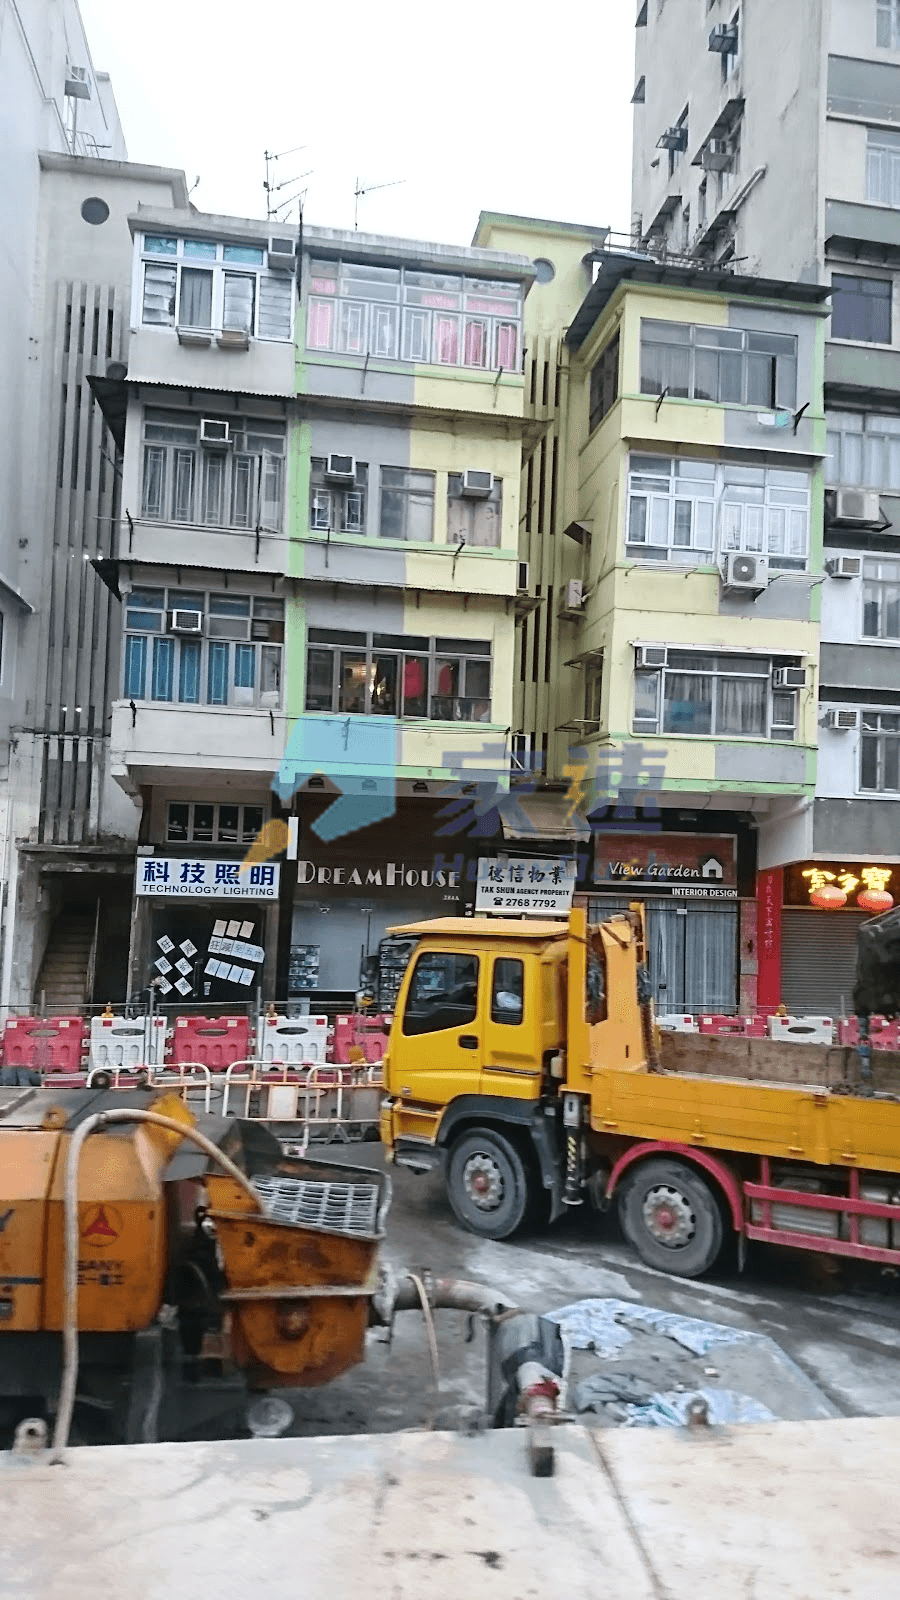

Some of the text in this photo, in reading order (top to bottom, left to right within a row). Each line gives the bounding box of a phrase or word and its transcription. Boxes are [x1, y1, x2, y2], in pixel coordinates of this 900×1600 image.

[143, 861, 275, 886] 科技照明
[608, 861, 700, 878] View Garden
[142, 884, 275, 896] TECHNOLOGY LIGHTING
[481, 886, 495, 894] TAK
[496, 886, 516, 895] SHUN
[516, 888, 539, 896] AGENCY
[671, 887, 739, 898] INTERIOR DESIGN
[505, 898, 557, 908] 2768 7792
